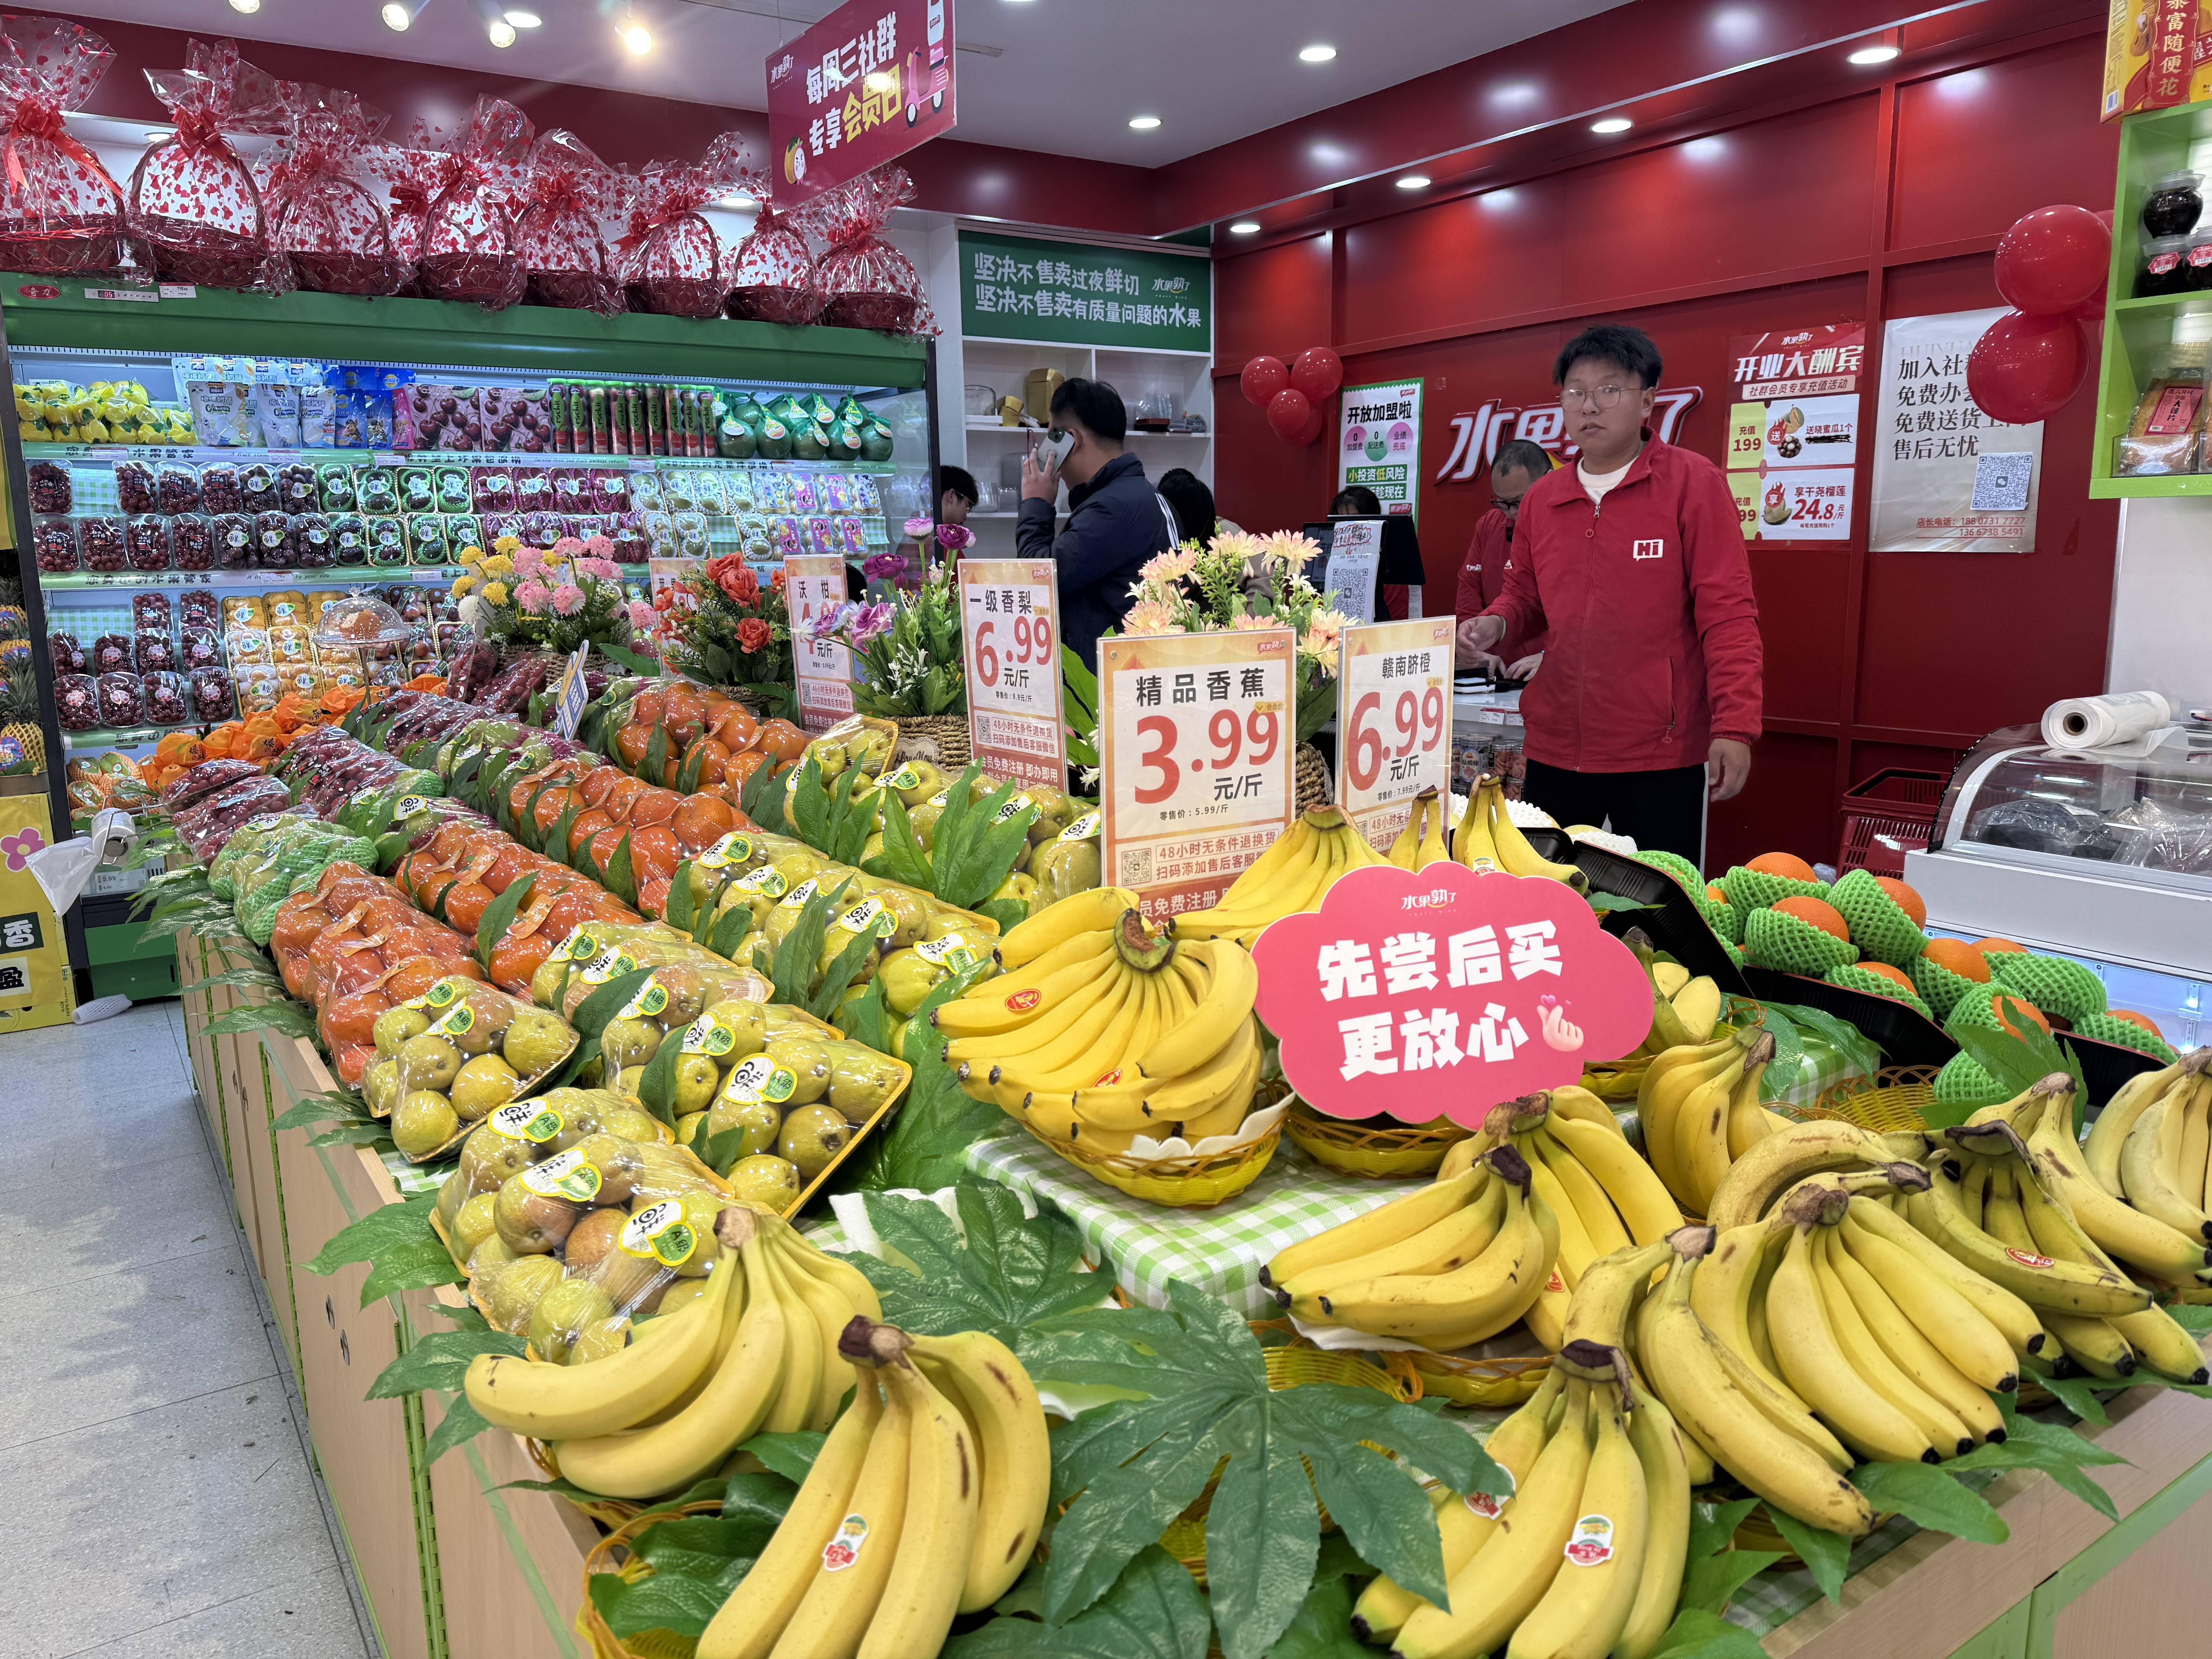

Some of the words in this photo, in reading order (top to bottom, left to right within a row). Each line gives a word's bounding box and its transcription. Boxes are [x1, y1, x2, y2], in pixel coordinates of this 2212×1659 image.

[806, 11, 896, 105] 每周三社群
[809, 63, 902, 156] 专享会员日
[974, 252, 1139, 295] 坚决不售卖过夜鲜切
[1152, 277, 1190, 293] 水果熟了
[975, 283, 1201, 328] 坚决不售卖有质量问题的水果
[1781, 332, 1813, 344] 水果熟了
[1734, 345, 1864, 382] 开业大酬宾
[1749, 379, 1848, 396] 社群会员专享充值活动
[1348, 400, 1412, 424] 开放加盟啦
[1354, 433, 1358, 441] 0
[1374, 431, 1379, 440] 0
[1394, 431, 1407, 440] 业绩
[1434, 387, 1701, 484] 水果了
[1739, 426, 1756, 435] 充值
[1771, 430, 1781, 441] 送
[1368, 441, 1384, 450] 配送费
[1393, 442, 1406, 451] 兜底
[1733, 438, 1761, 452] 199
[1893, 435, 1979, 460] 售后无忧
[1348, 467, 1405, 482] 小投资低风险
[1735, 497, 1751, 506] 充值
[1769, 495, 1779, 505] 享
[1791, 498, 1834, 520] 24.8
[1961, 517, 1975, 526] 188
[1978, 517, 1999, 525] 0731
[2003, 517, 2025, 525] 7727
[970, 589, 1032, 615] 一级香梨
[817, 643, 833, 659] 元/斤
[975, 616, 1052, 687] 6.99
[1382, 652, 1431, 680] 赣南脐橙
[1004, 668, 1029, 688] 元/斤
[1136, 668, 1264, 707] 精品香蕉
[1266, 702, 1284, 711] 会员价
[994, 720, 1053, 739] 48小时无条件退换货
[1348, 687, 1444, 791] 6.99
[993, 733, 1055, 754] 扫码添加售后客服微信
[1135, 709, 1278, 804] 3.99
[982, 755, 1024, 776] 会员免费注册
[1026, 763, 1058, 783] 即办即用
[1390, 754, 1420, 782] 元/斤
[1214, 773, 1262, 801] 元/斤
[1159, 831, 1276, 860] 48小时无条件退换货
[1370, 829, 1404, 849] 扫码添加
[1401, 889, 1456, 910] 水果熟了
[0, 919, 34, 948] 香
[1317, 920, 1563, 1002] 先尝后买
[1338, 1002, 1529, 1082] 更放心
[661, 1243, 672, 1260] FRUIT
[664, 1231, 675, 1251] FRESH
